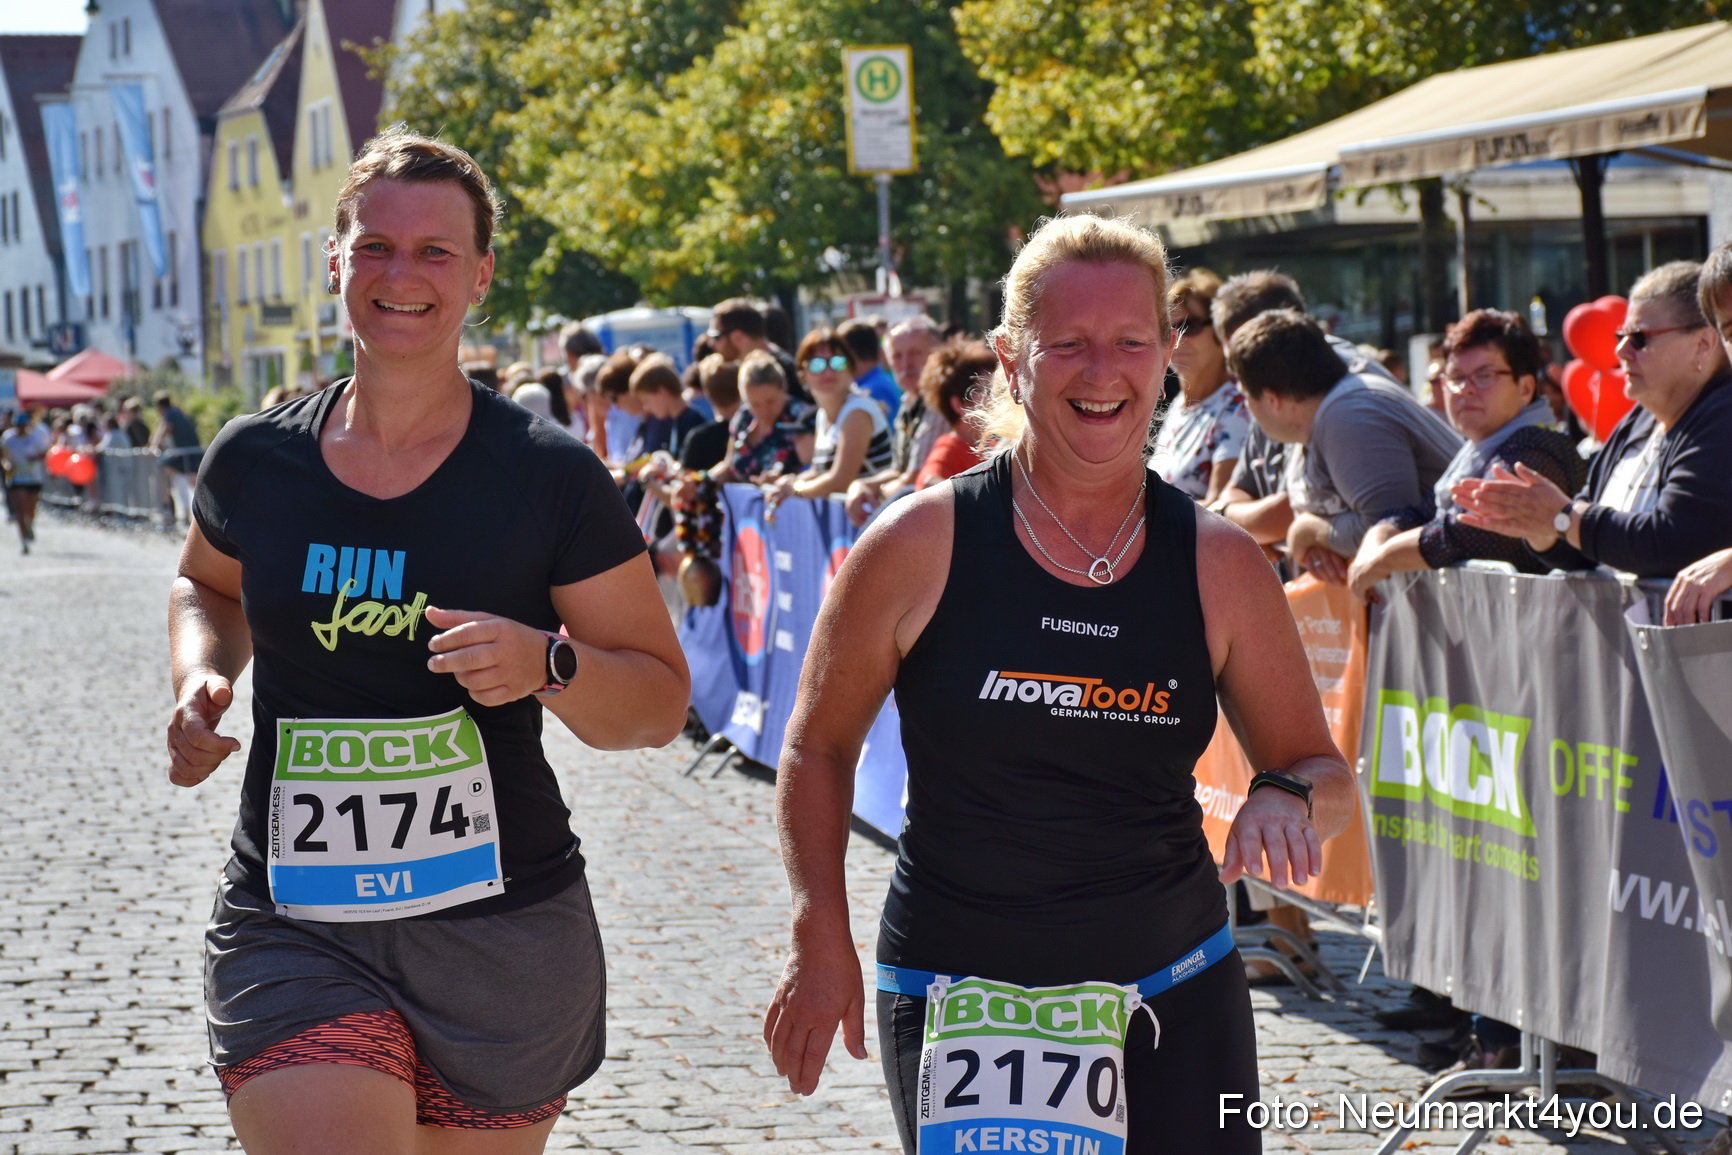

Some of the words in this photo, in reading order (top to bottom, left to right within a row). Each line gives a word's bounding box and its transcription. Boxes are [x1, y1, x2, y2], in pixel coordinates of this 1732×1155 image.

[868, 69, 889, 92] H
[301, 543, 406, 600] RUN
[311, 578, 427, 652] fast
[1050, 707, 1099, 719] GERMAN
[1103, 711, 1140, 723] TOOLS
[1143, 714, 1181, 726] GROUP
[288, 720, 469, 772] BOCK
[1377, 703, 1523, 819] BOCK
[473, 781, 482, 792] D
[293, 784, 470, 852] 2174
[355, 869, 413, 898] EVI
[1171, 949, 1206, 977] ERDINGER
[943, 988, 1121, 1039] BOCK
[944, 1049, 1118, 1118] 2170
[954, 1127, 1101, 1155] KERSTIN
